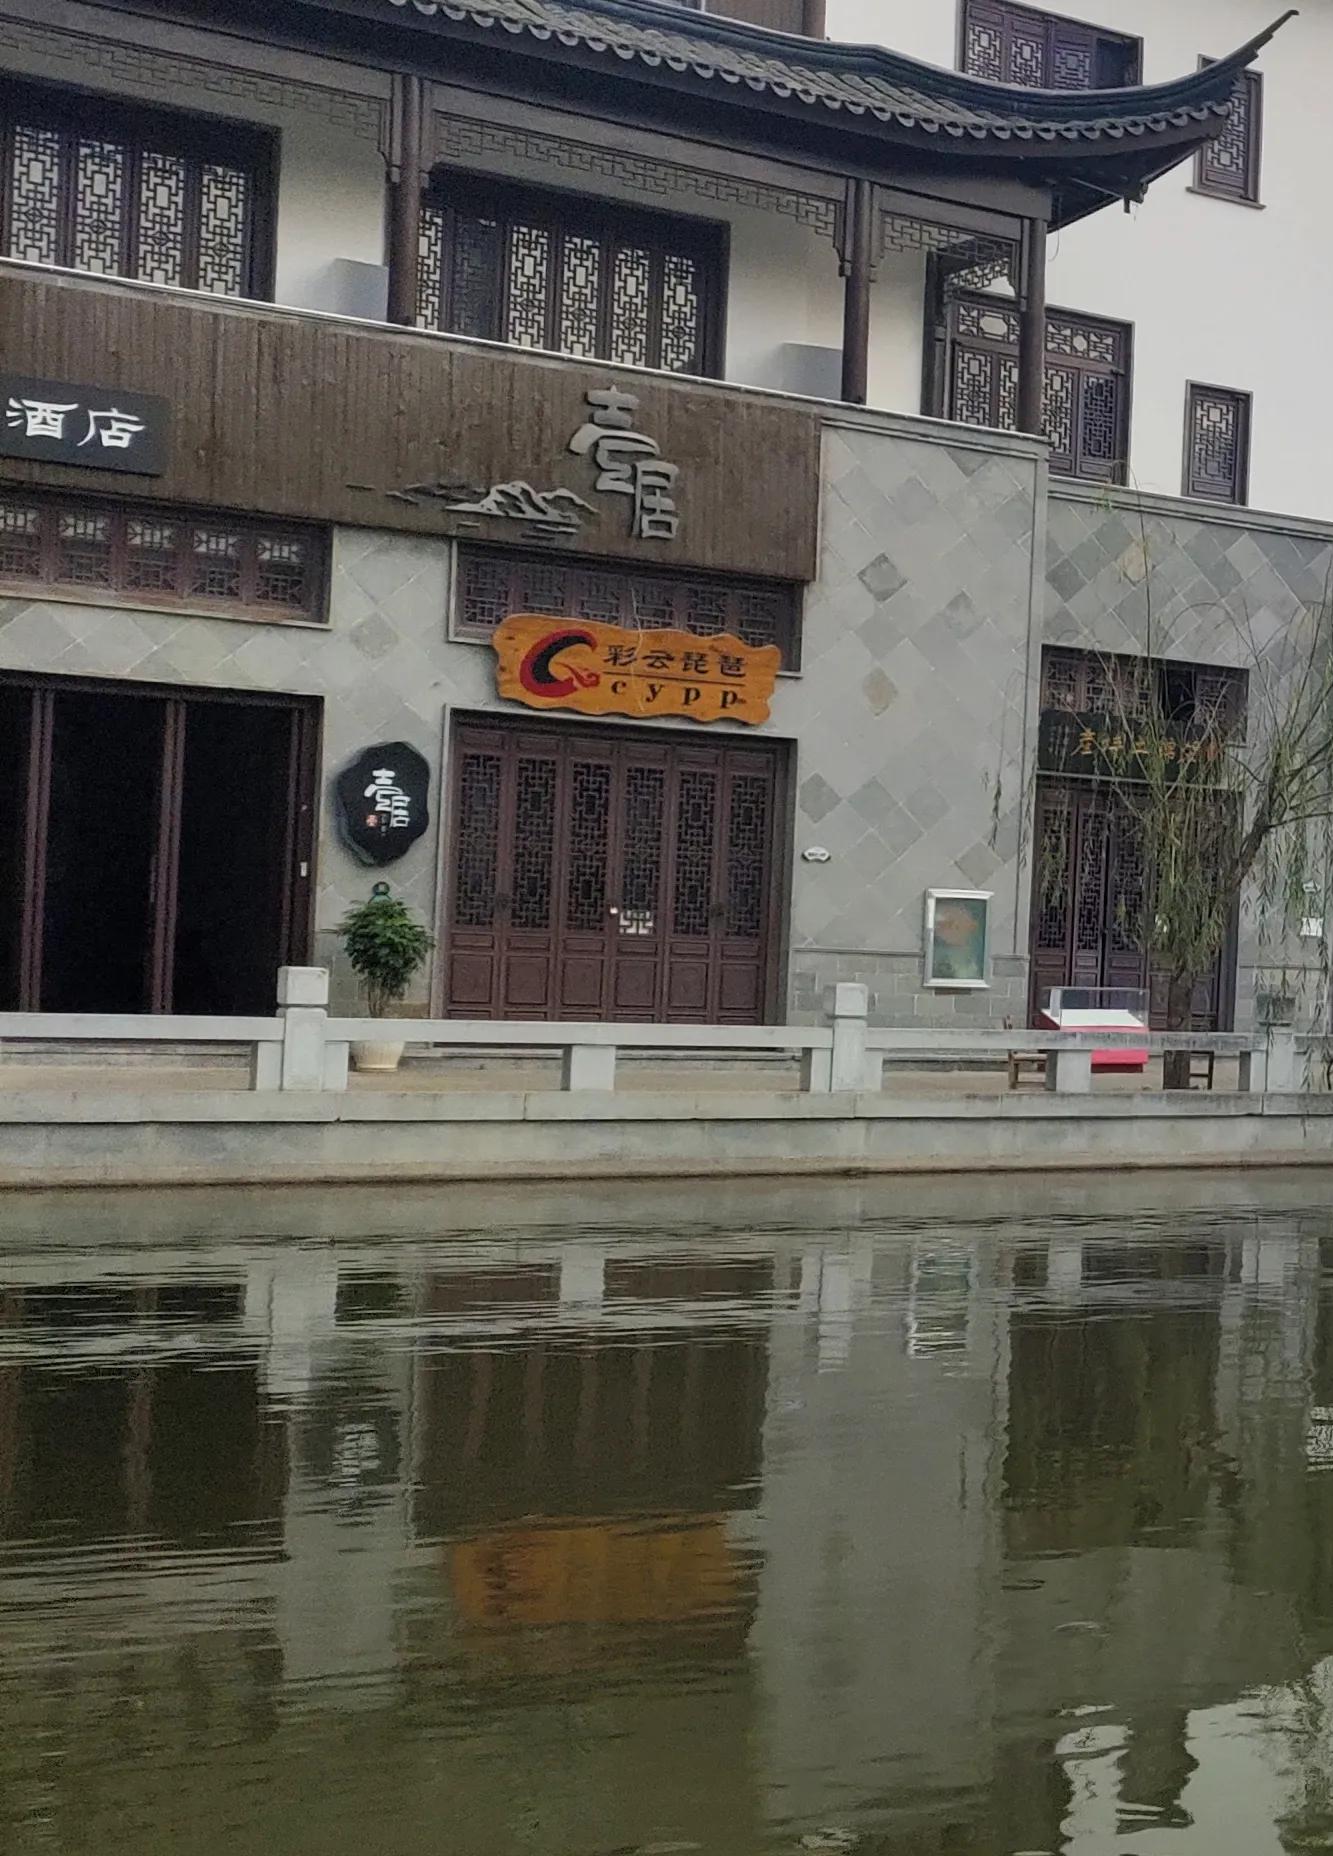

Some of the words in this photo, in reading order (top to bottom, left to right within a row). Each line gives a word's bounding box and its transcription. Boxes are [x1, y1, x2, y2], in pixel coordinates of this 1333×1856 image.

[6, 398, 146, 448] 酒店
[603, 644, 746, 678] 彩云琵琶
[611, 680, 739, 708] cypp
